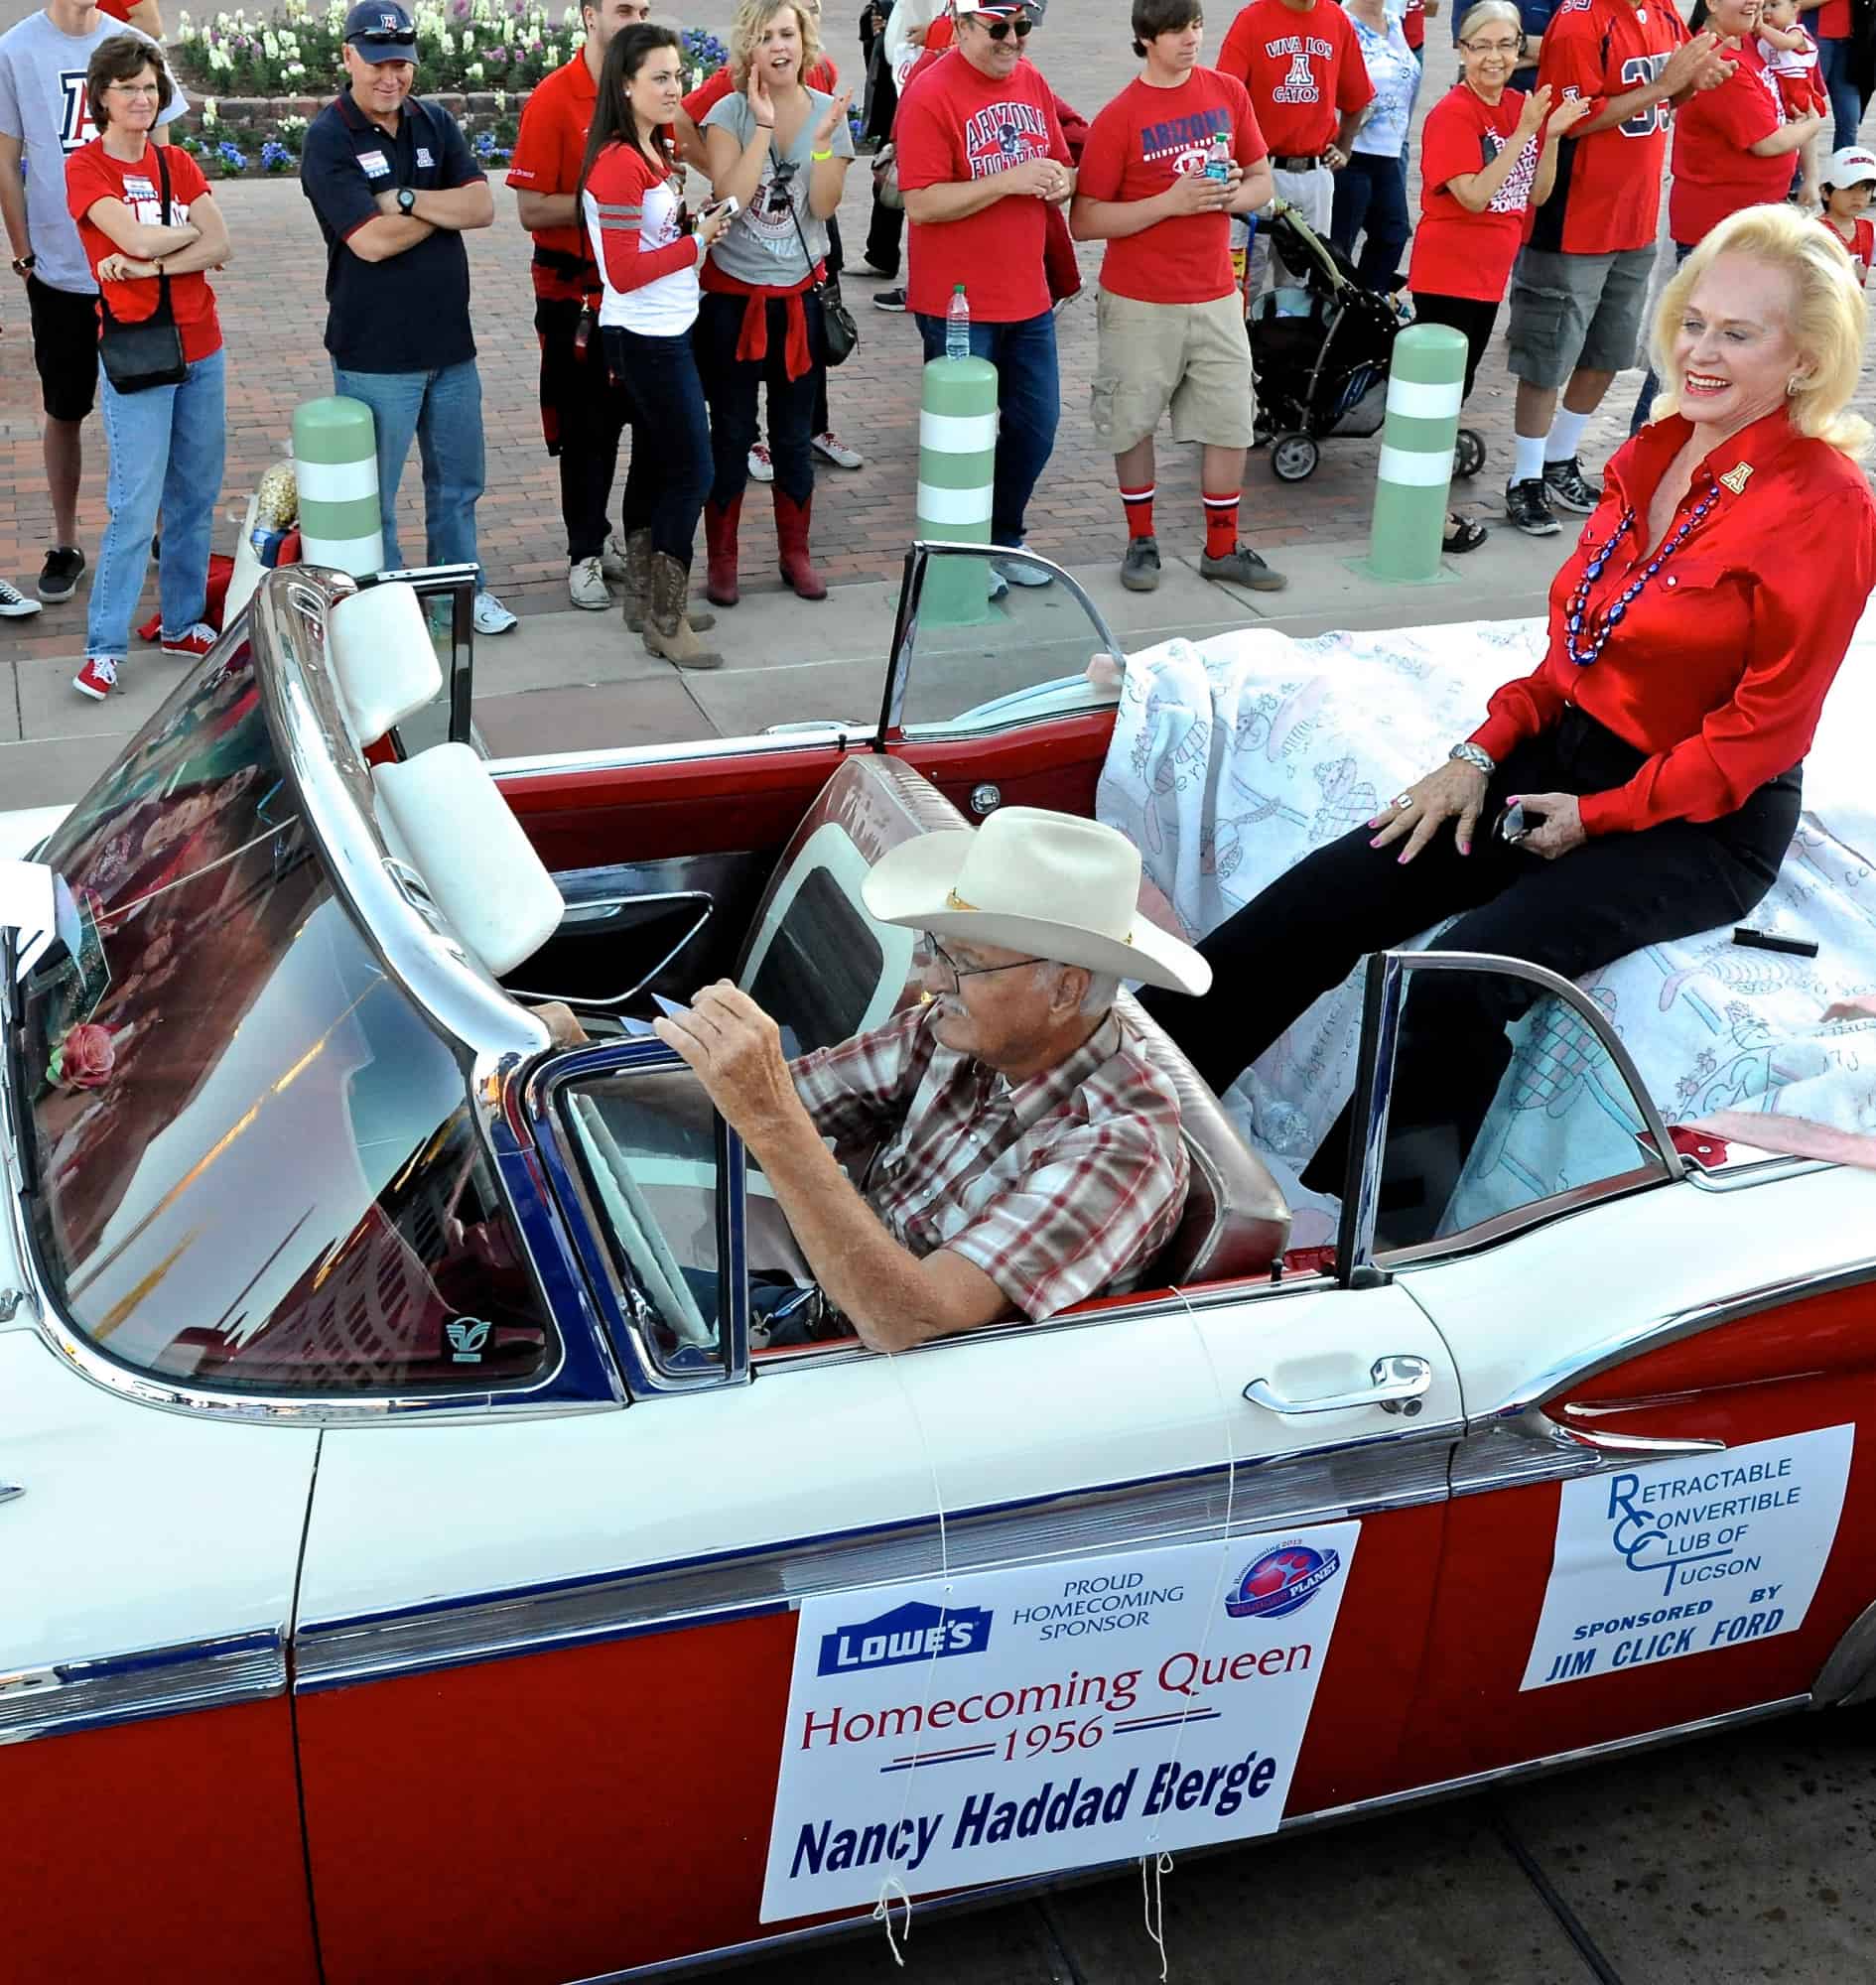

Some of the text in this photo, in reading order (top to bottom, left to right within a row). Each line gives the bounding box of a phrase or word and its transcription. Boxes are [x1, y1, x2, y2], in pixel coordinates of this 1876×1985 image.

[1266, 36, 1332, 61] VIVA LOS
[1285, 54, 1314, 86] A
[1273, 85, 1319, 103] GATOS
[966, 102, 1048, 159] ARIZONA
[1141, 107, 1231, 152] ARIZONA
[1719, 462, 1754, 494] A
[1608, 1458, 1793, 1527] RETRACTABLE
[1613, 1487, 1802, 1554] CONVERTIBLE
[1627, 1524, 1749, 1571] CLUB OF
[1064, 1572, 1143, 1598] PROUD
[1290, 1559, 1337, 1597] PLANET
[1664, 1548, 1762, 1597] TUCSON
[1012, 1586, 1184, 1625] HOMECOMING
[1039, 1611, 1150, 1641] SPONSOR
[1572, 1584, 1784, 1641] SPONSORED BY
[837, 1620, 975, 1667] LOWE'S
[1545, 1608, 1785, 1682] JIM CLICK FORD
[800, 1643, 1312, 1750] Homecoming Queen
[1004, 1715, 1105, 1762] 1956
[789, 1750, 1276, 1879] Nancy Haddad Berge
